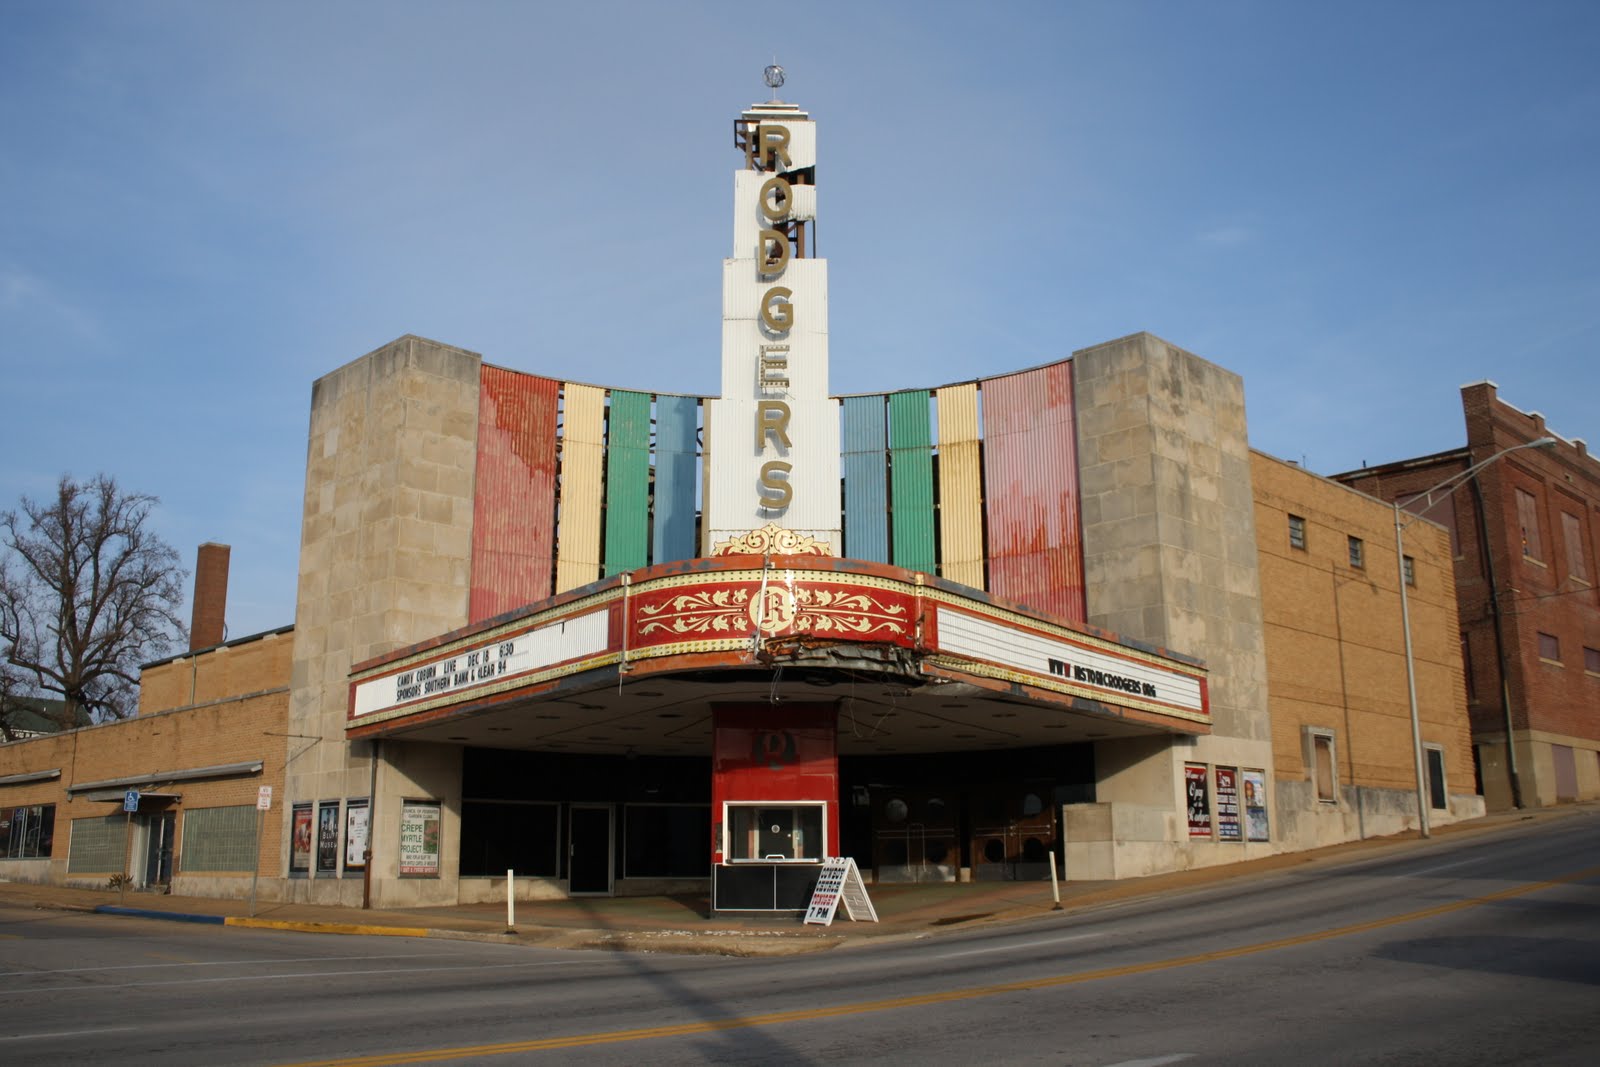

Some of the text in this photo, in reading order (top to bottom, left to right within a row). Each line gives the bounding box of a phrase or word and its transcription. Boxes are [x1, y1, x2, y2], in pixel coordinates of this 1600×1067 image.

[757, 125, 794, 510] RODGERS
[397, 643, 514, 688] CANDY COBURN LIVE DEC 18 6:30
[396, 684, 422, 702] SPONSORS
[424, 676, 451, 695] SOUTHERN
[454, 672, 469, 687] BANK
[477, 663, 495, 679] CLEAR
[497, 660, 507, 674] 94
[401, 824, 423, 832] CREPE
[400, 834, 422, 843] MYRTLE
[400, 844, 422, 853] PROJECT
[809, 907, 829, 918] 7 PM
